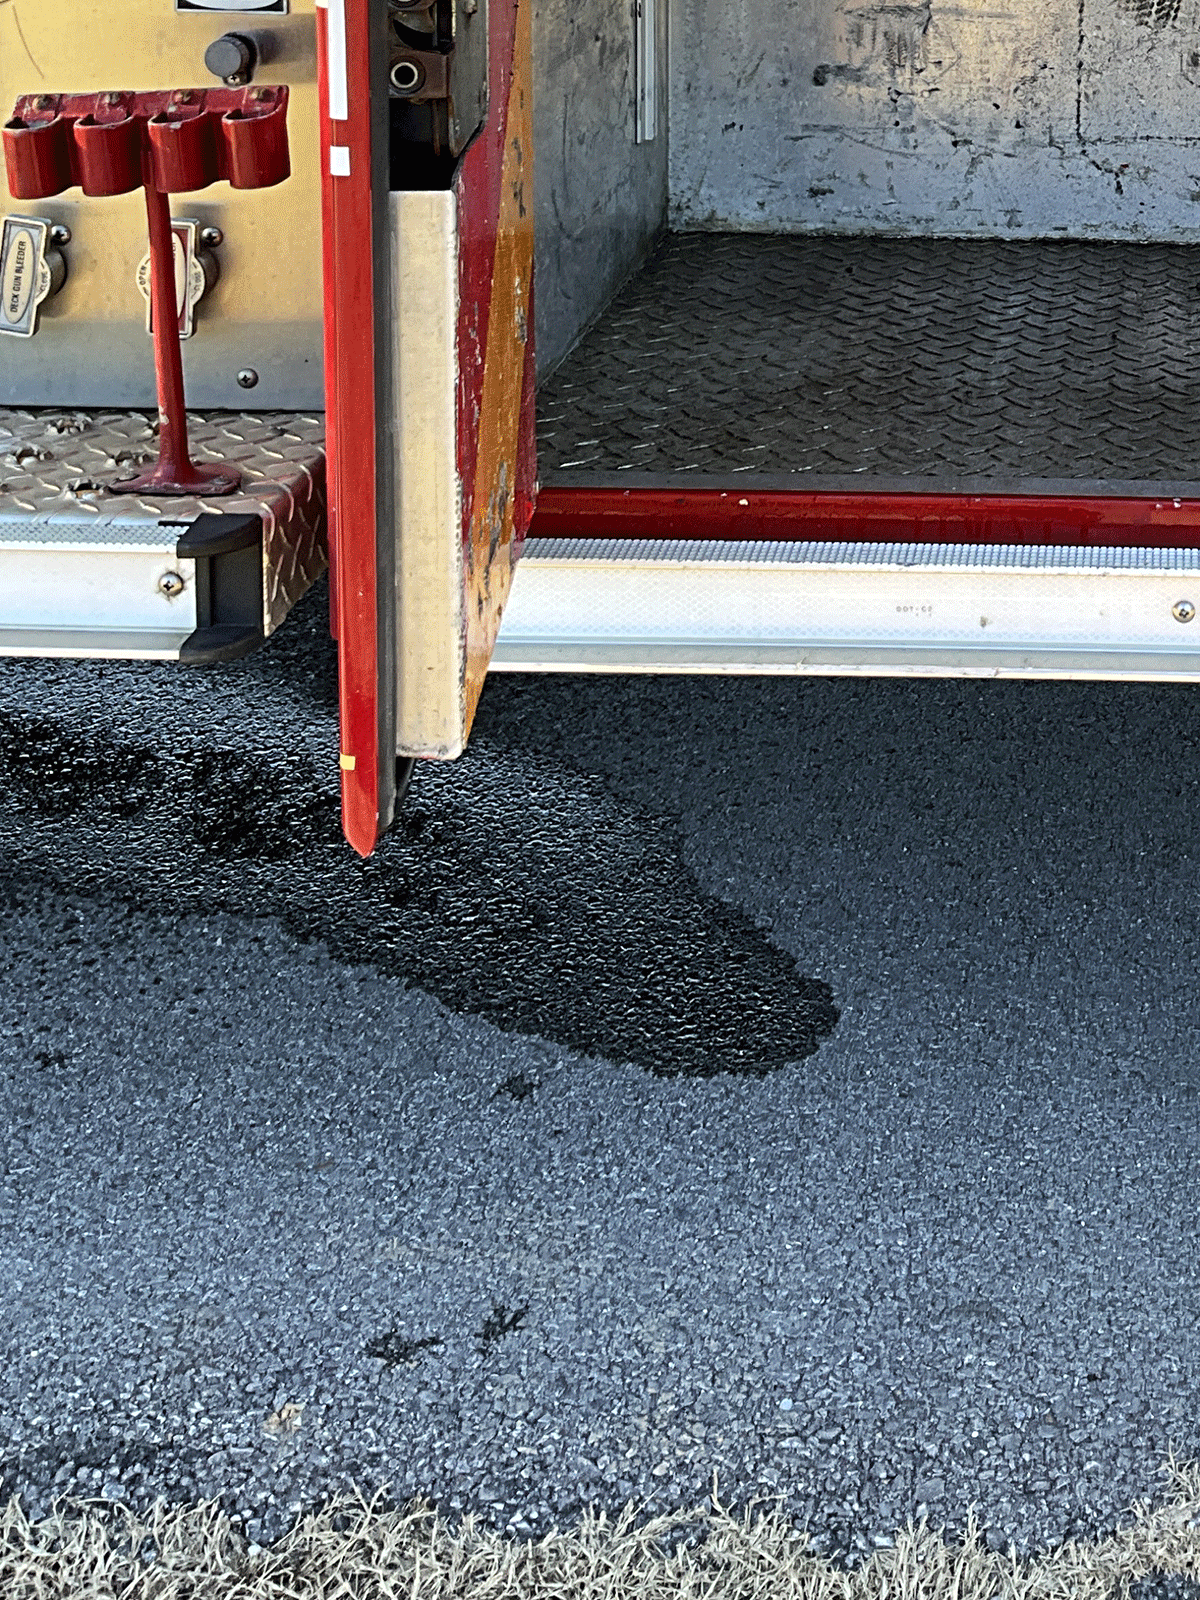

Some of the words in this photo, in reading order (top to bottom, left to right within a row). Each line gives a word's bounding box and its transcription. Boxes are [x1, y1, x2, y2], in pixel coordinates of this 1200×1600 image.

[14, 240, 26, 274] BLEEDER
[12, 275, 22, 292] GUN
[138, 265, 147, 286] OPEN
[10, 294, 20, 313] DECK
